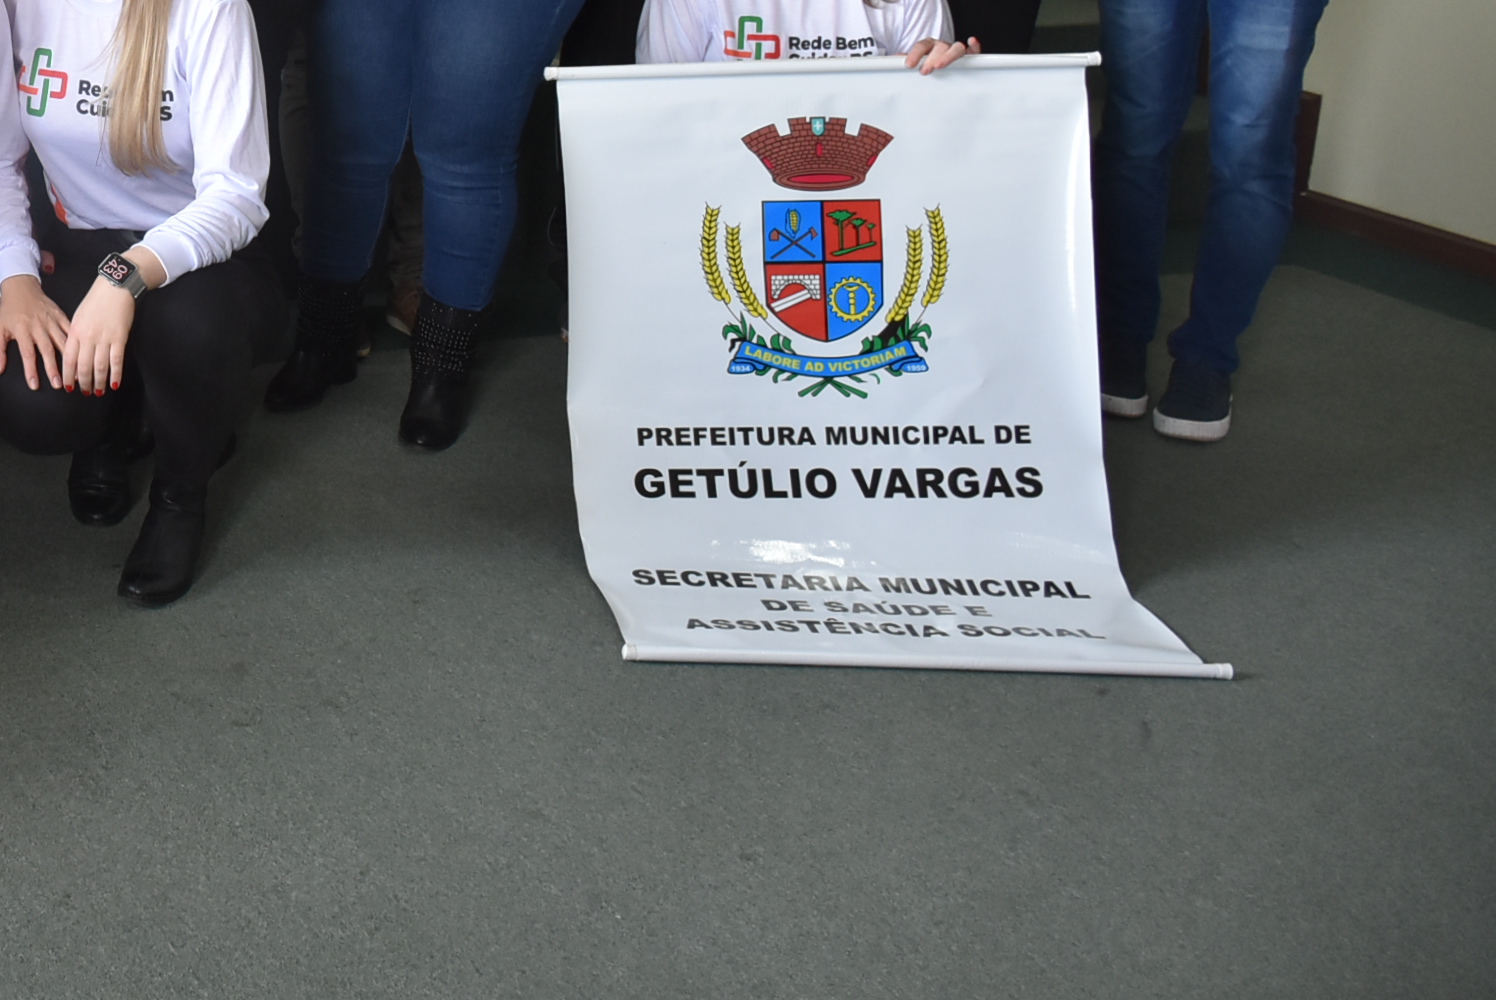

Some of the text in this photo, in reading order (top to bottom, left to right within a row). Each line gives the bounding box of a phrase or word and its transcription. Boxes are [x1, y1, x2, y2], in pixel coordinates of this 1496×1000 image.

[788, 36, 875, 50] Rede Bem
[745, 345, 907, 372] LABORE AD VICTORIAM
[637, 425, 1032, 446] PREFEITURA MUNICIPAL DE
[634, 461, 1044, 499] GETÚLIO VARGAS
[632, 569, 1092, 599] SECRETARIA MUNICIPAL
[760, 599, 993, 617] DE SAÚDE E
[686, 617, 1107, 640] ASSISTÊNCIA SOCIAL
